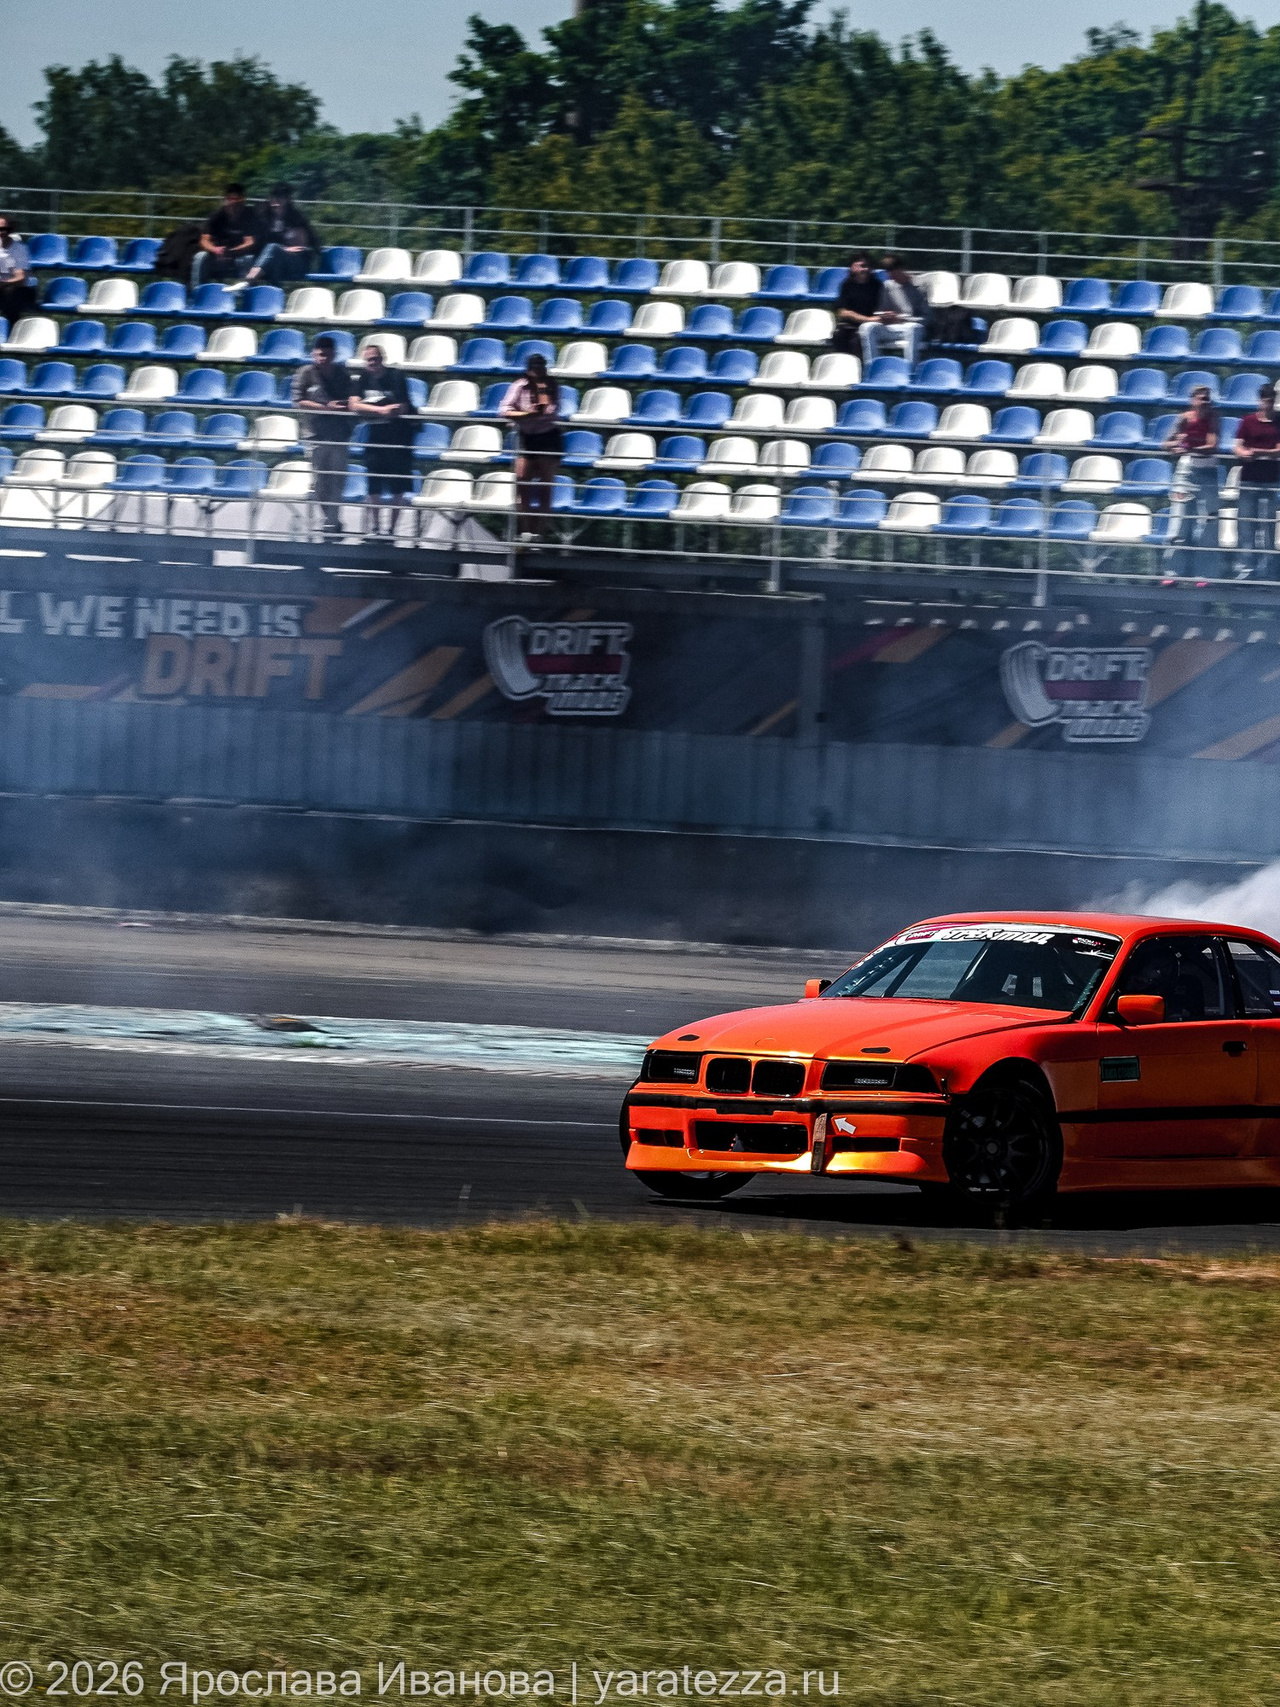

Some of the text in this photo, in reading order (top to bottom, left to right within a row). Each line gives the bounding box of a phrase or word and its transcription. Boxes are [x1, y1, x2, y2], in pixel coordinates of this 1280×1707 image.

[40, 592, 123, 637] WE
[134, 597, 250, 640] NEED
[258, 604, 302, 637] IS
[530, 628, 629, 655] DRIFT
[139, 634, 343, 699] DRIFT
[1047, 653, 1148, 681] DRIFT
